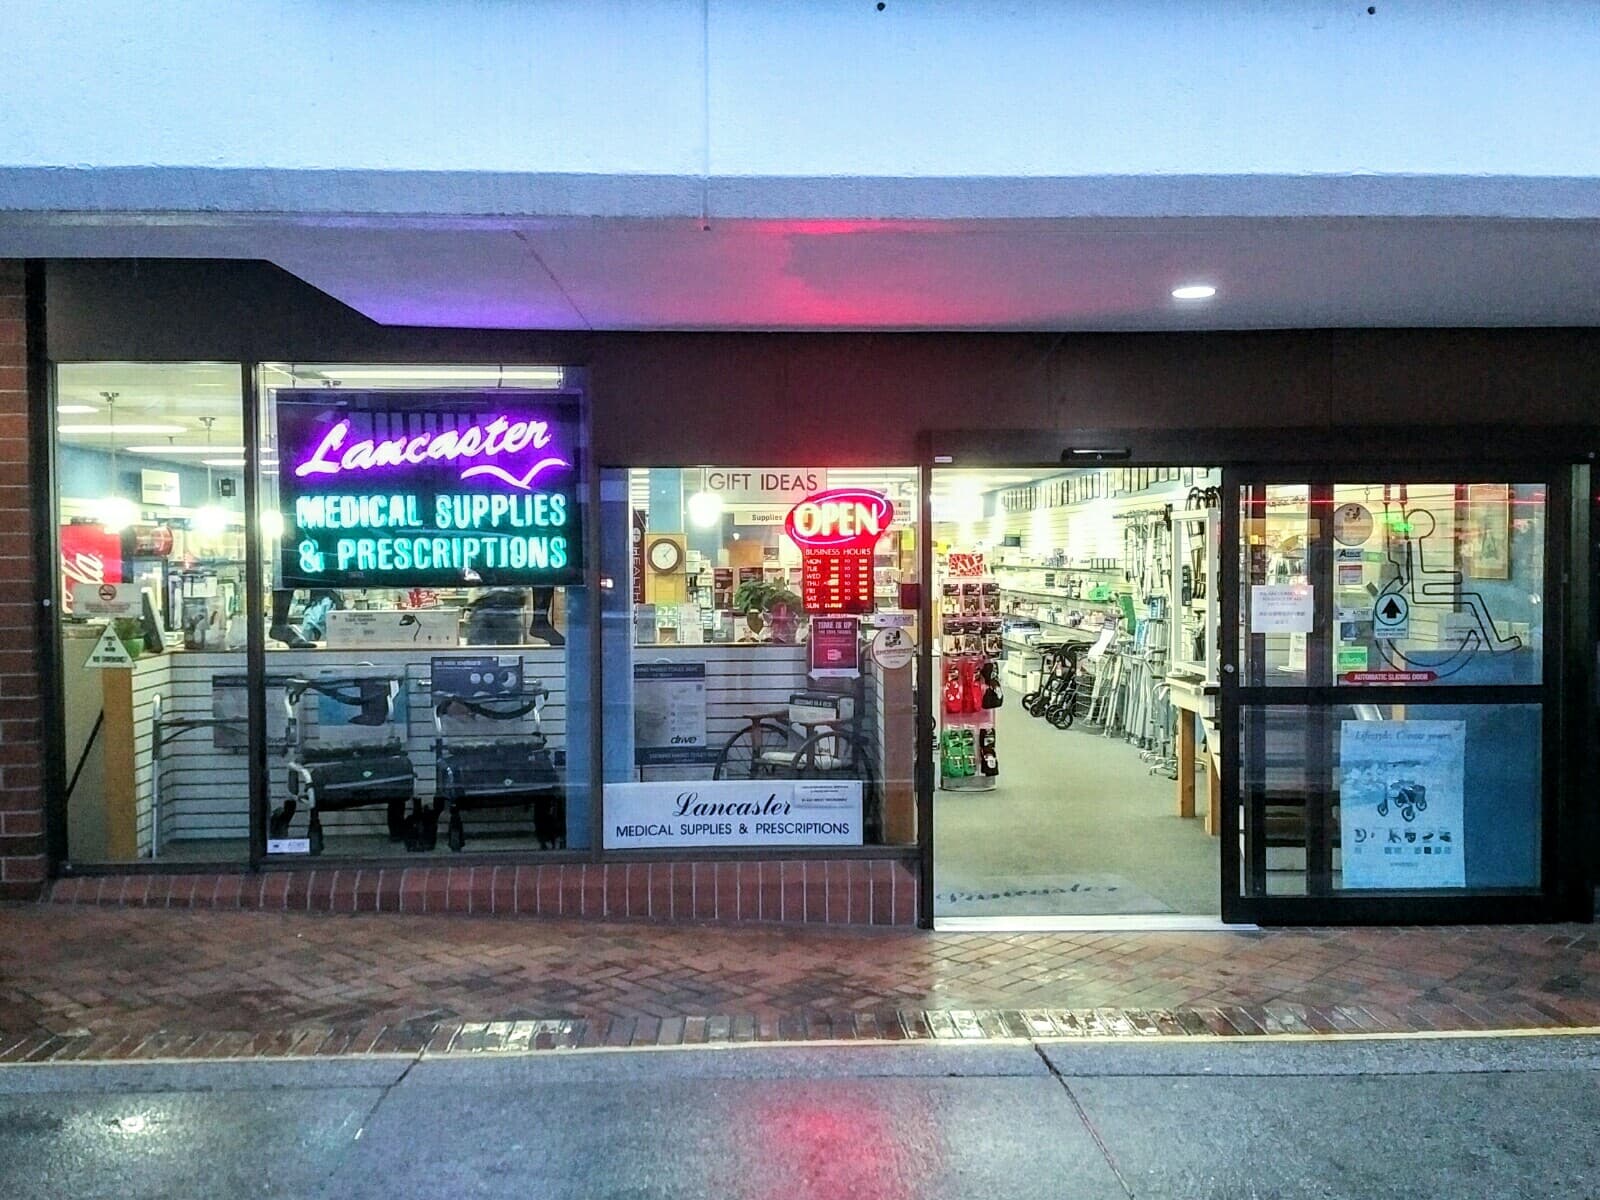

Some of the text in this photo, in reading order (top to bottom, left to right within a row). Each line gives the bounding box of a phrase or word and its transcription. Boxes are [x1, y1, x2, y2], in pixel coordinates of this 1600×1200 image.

[296, 415, 552, 477] Lancaster
[708, 472, 818, 491] GIFT IDEAS
[296, 493, 567, 529] MEDICAL SUPPLIES
[751, 513, 783, 523] Supplies
[794, 501, 878, 536] OPEN
[298, 536, 568, 573] & PRESCRIPTIONS
[805, 548, 871, 556] BUSINESS HOURS
[1354, 673, 1428, 681] AUTOMATIC SLIDING DOOR
[671, 735, 697, 744] drive
[672, 791, 792, 817] Lancaster
[616, 822, 850, 837] MEDICAL SUPPLIES & PRESCRIPTIONS
